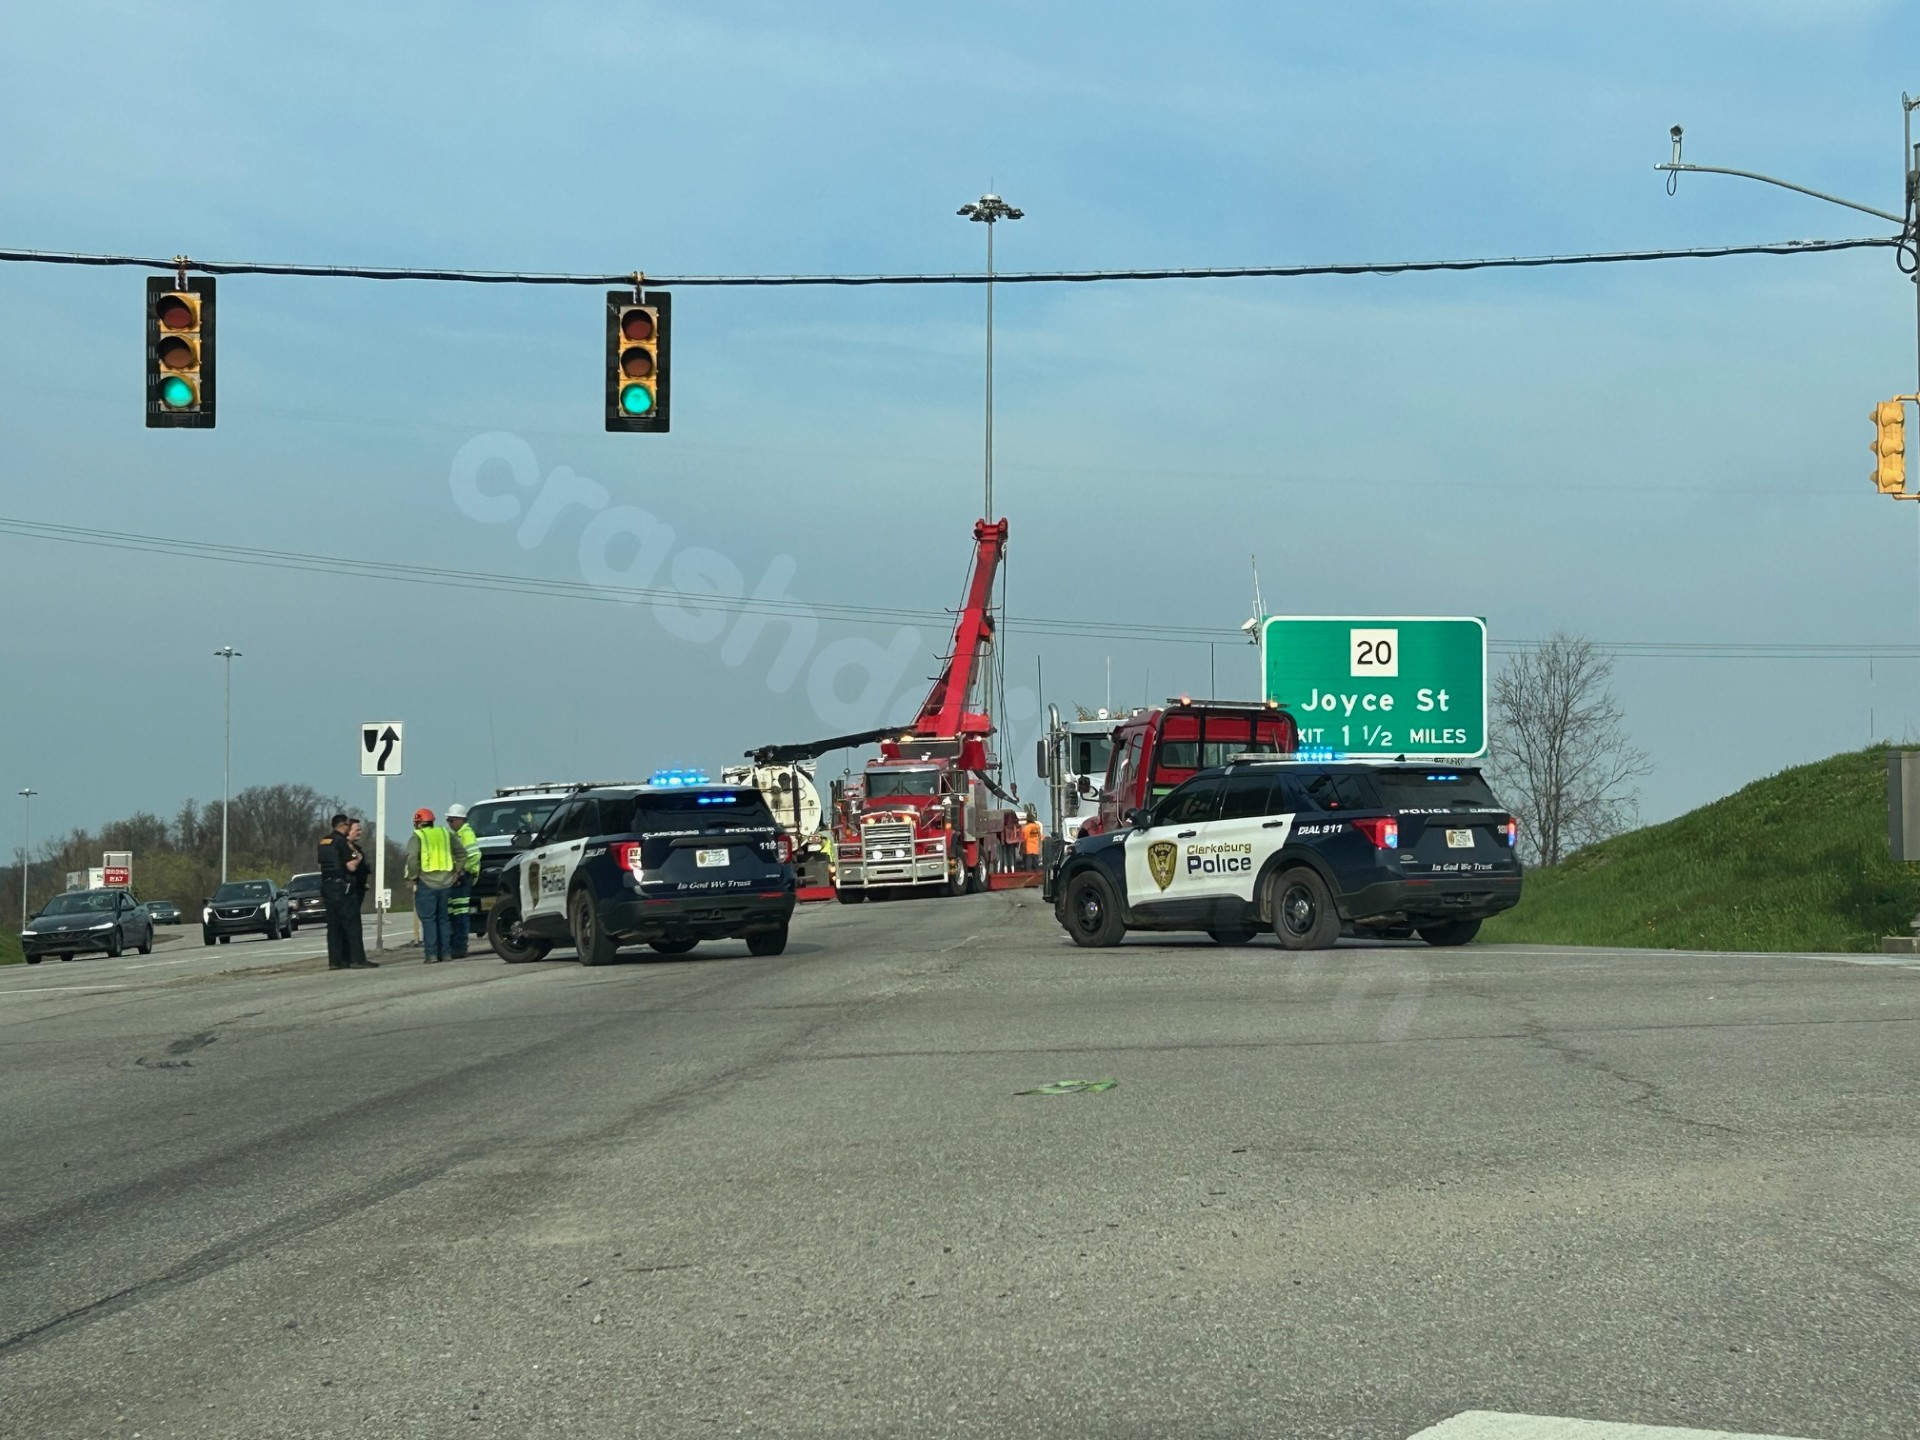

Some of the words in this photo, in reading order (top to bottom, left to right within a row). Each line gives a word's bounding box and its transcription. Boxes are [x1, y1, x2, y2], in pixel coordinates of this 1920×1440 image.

[1356, 640, 1392, 665] 20
[1301, 688, 1394, 717] Joyce
[1416, 688, 1450, 712] St
[1297, 728, 1324, 744] XIT
[1342, 725, 1350, 746] 1
[1410, 728, 1467, 744] MILES
[1298, 825, 1320, 835] DIAL
[1322, 823, 1343, 833] 911
[1187, 854, 1252, 874] Police
[1443, 863, 1459, 871] God
